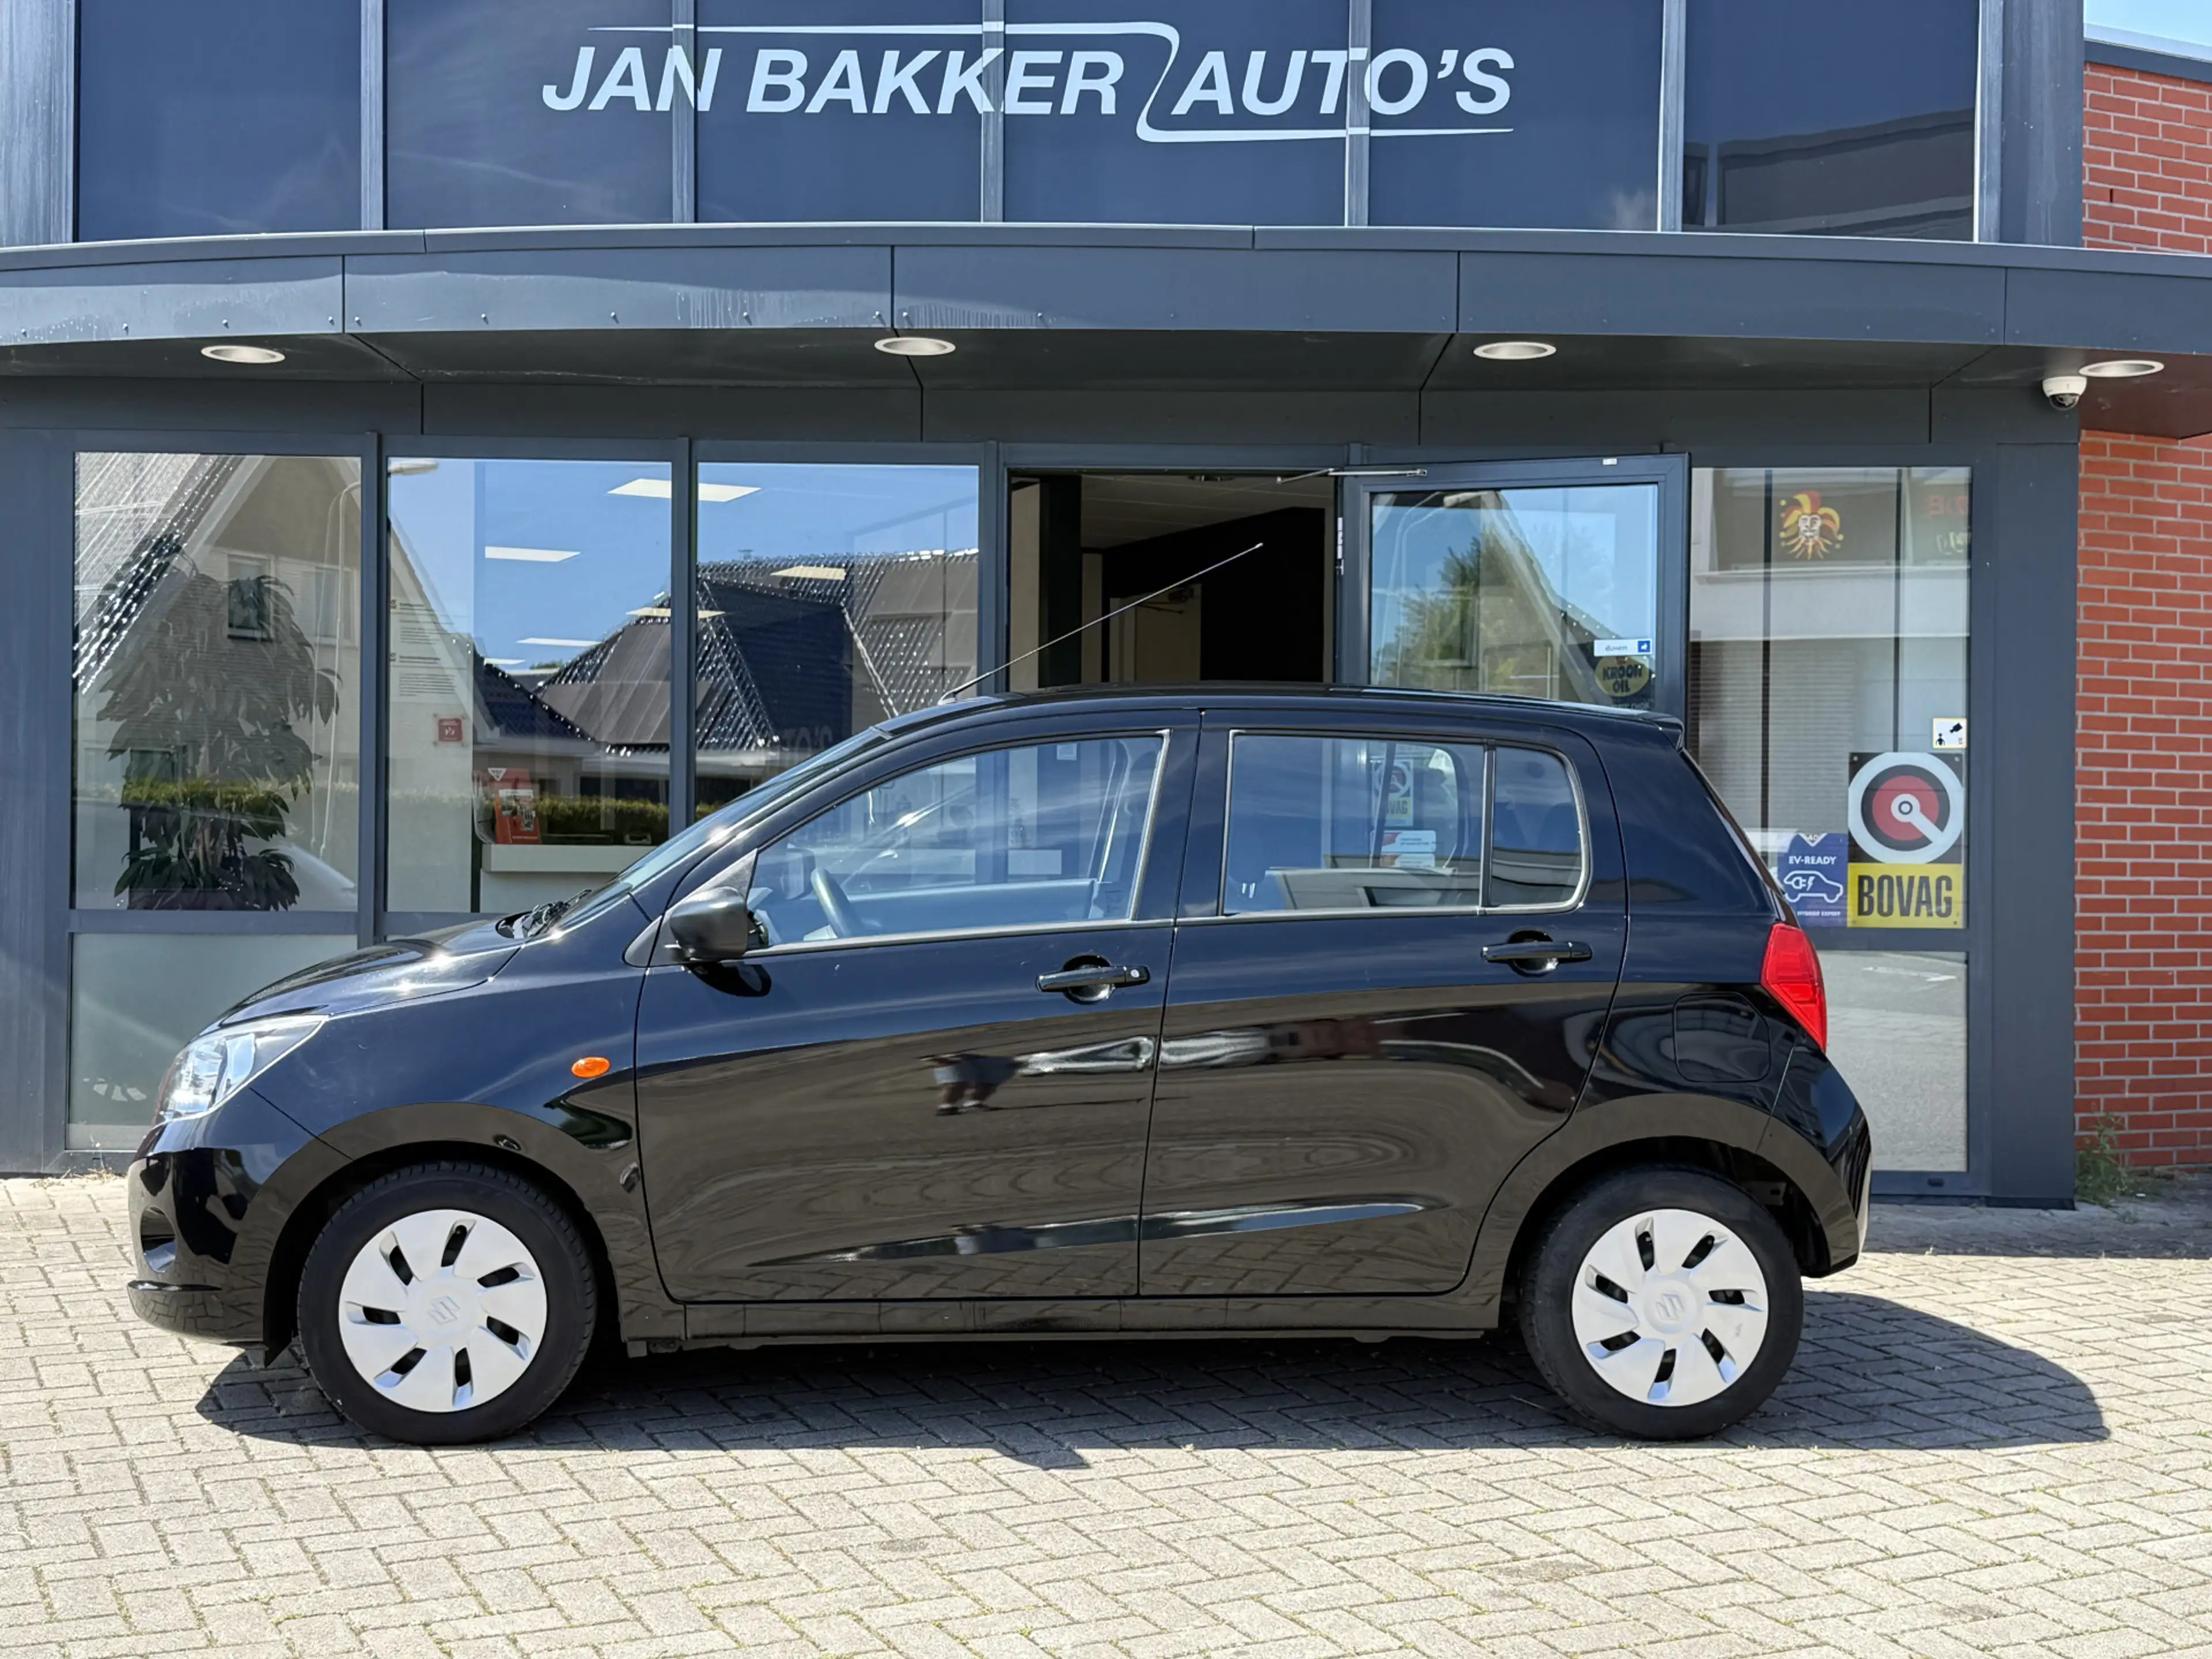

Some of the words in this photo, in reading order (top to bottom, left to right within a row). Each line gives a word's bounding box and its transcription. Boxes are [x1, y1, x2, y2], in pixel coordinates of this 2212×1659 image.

[543, 46, 722, 111] JAN
[747, 48, 1124, 114] BAKKER
[1171, 47, 1514, 115] AUTO'S
[1613, 680, 1630, 693] OIL
[1789, 855, 1837, 865] EV-READY
[1858, 874, 1952, 918] BOVAG
